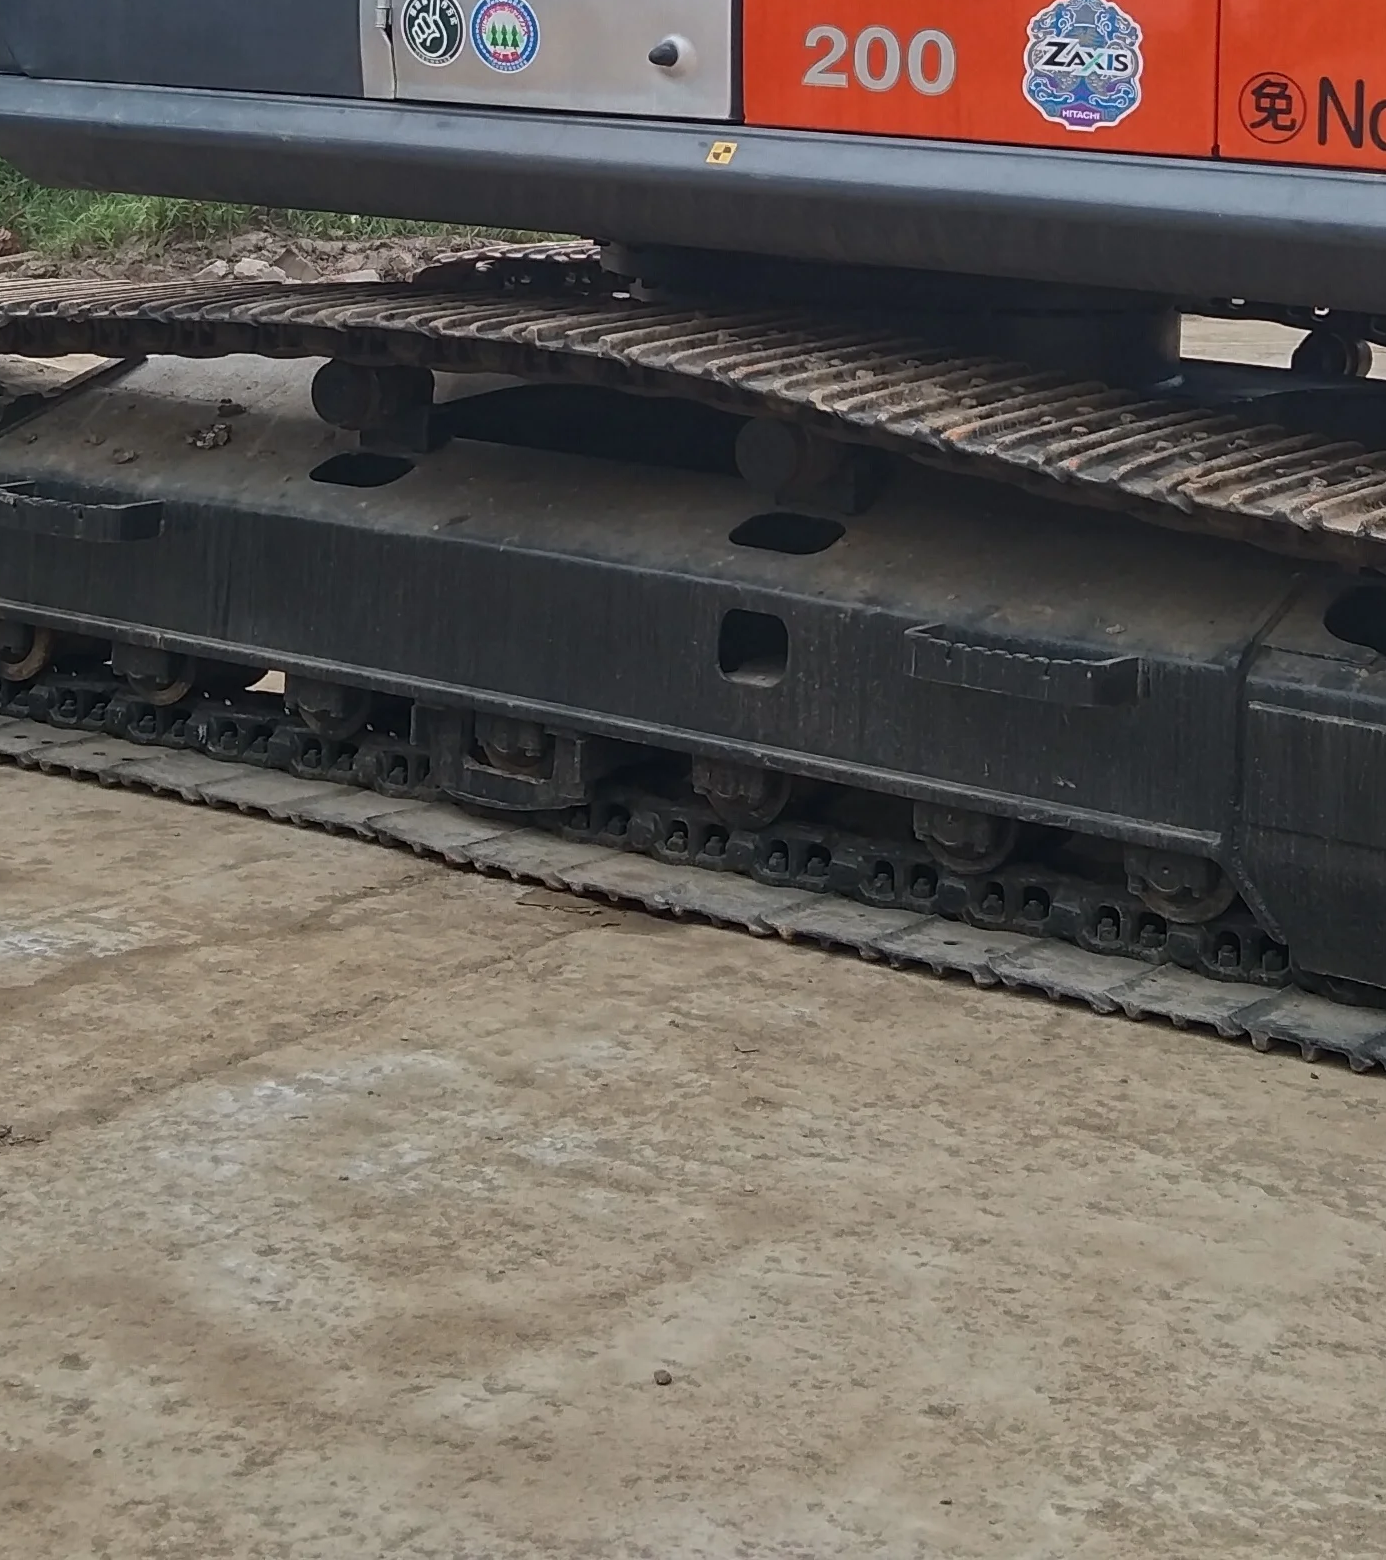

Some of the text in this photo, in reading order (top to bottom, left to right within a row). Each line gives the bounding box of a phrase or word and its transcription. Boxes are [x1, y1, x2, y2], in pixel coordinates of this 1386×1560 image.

[801, 23, 958, 97] 200
[1041, 41, 1129, 72] ZAXIS
[1061, 109, 1101, 120] HITACHI
